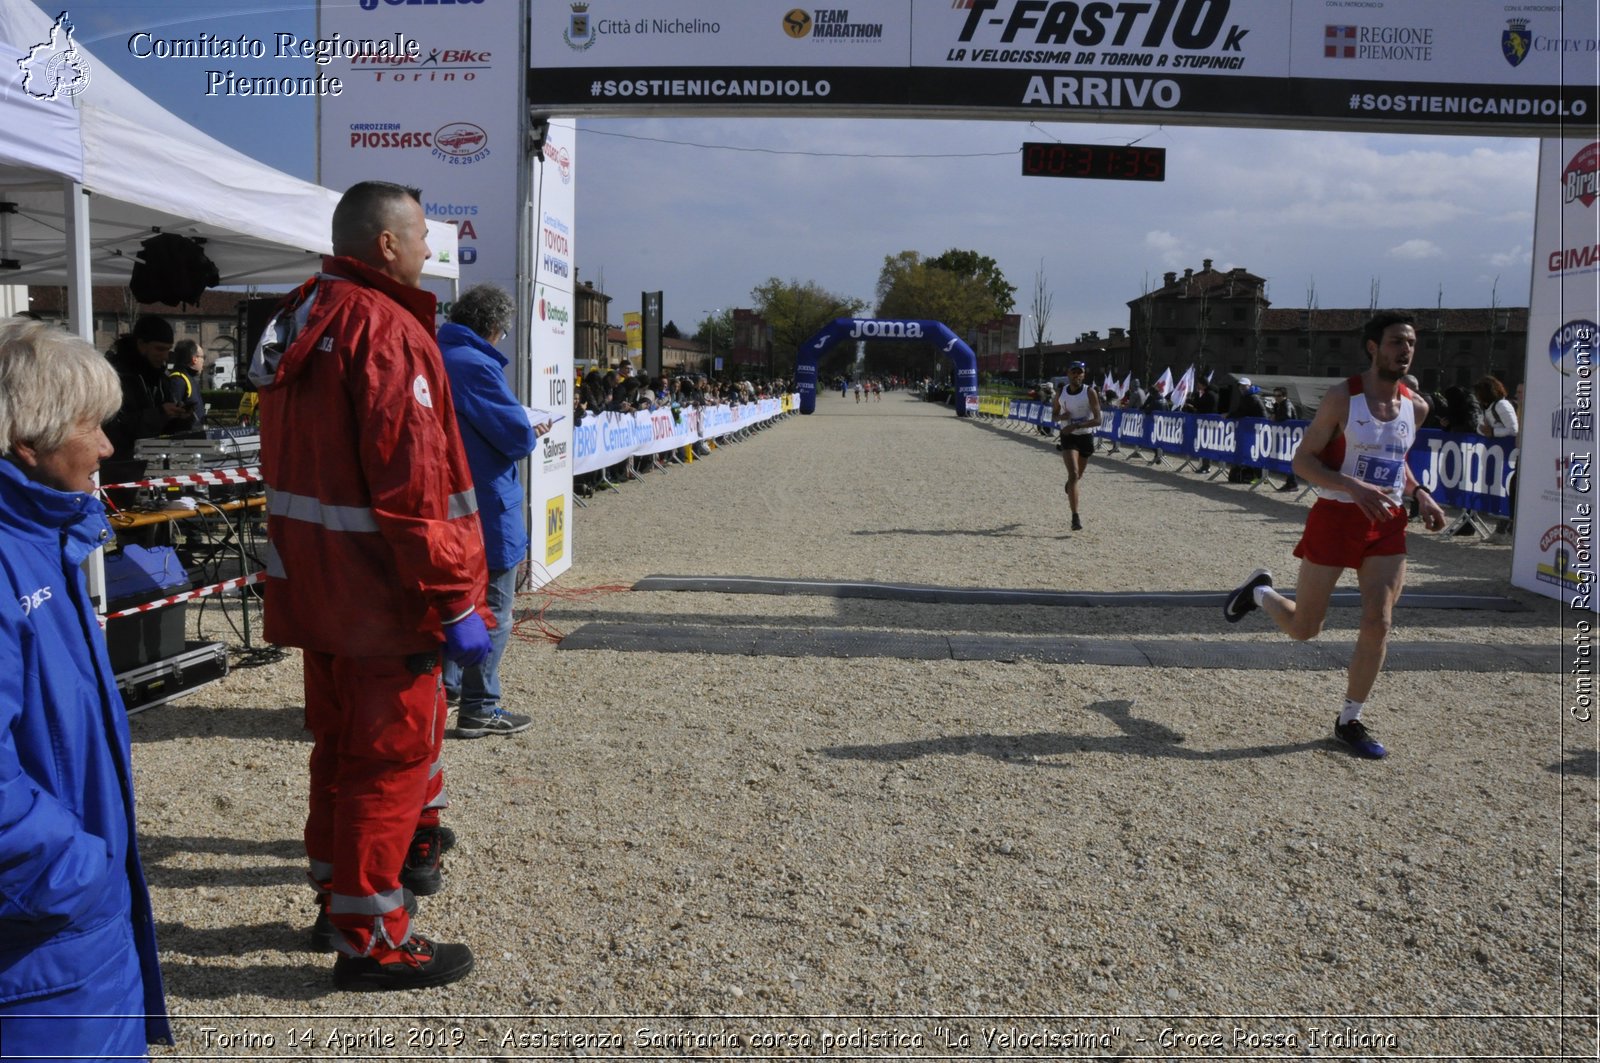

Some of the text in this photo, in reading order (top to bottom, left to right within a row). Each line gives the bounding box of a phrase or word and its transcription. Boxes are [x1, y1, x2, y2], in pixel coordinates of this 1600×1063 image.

[814, 9, 848, 23] TEAM
[598, 18, 721, 34] Città di Nichelino
[813, 24, 883, 38] MARATHON
[1360, 27, 1433, 45] REGIONE
[442, 50, 491, 64] Bike
[947, 49, 1245, 70] LA VELOCISSIMA DA TORINO A STUPINIGI
[1359, 45, 1432, 61] PIEMONTE
[374, 71, 476, 82] Torino
[591, 79, 831, 96] #SOSTIENICANDIOLO
[1022, 75, 1181, 108] ARRIVO
[1349, 94, 1587, 116] #SOSTIENICANDIOLO
[350, 123, 400, 131] CARROZZERIA
[351, 132, 432, 149] PIOSSASC
[431, 148, 447, 162] 011
[425, 203, 478, 216] Motors
[544, 228, 568, 256] TOYOTA
[544, 253, 568, 278] HYBRID
[549, 379, 567, 406] iren
[651, 415, 674, 440] TOYOTA
[1373, 466, 1390, 480] 82
